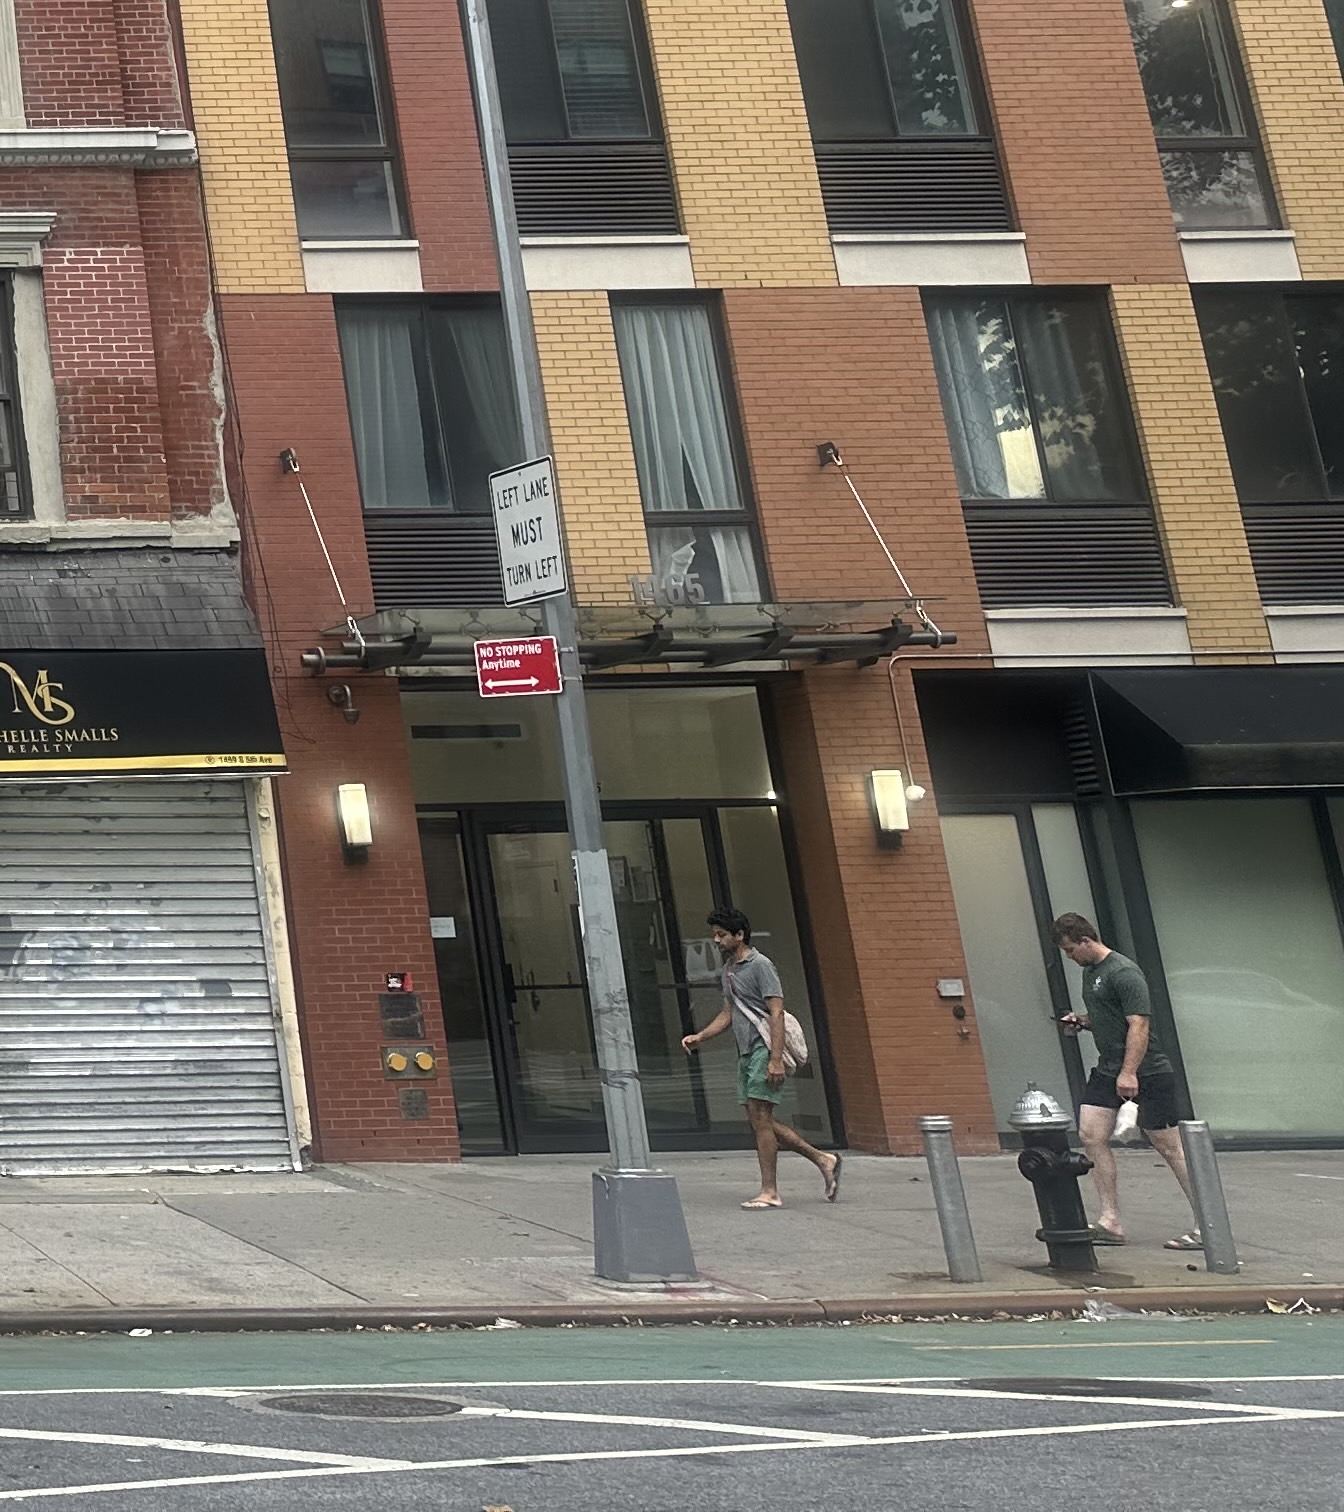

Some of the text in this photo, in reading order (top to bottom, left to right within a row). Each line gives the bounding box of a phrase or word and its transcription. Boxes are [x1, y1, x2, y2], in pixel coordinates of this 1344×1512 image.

[497, 477, 550, 510] LEFT LANE
[511, 517, 543, 548] MUST
[507, 556, 558, 586] TURN LEFT
[480, 643, 542, 658] NO STOPPING
[482, 656, 521, 671] Anytime
[55, 727, 119, 742] SMALLS
[8, 743, 74, 754] REALTY
